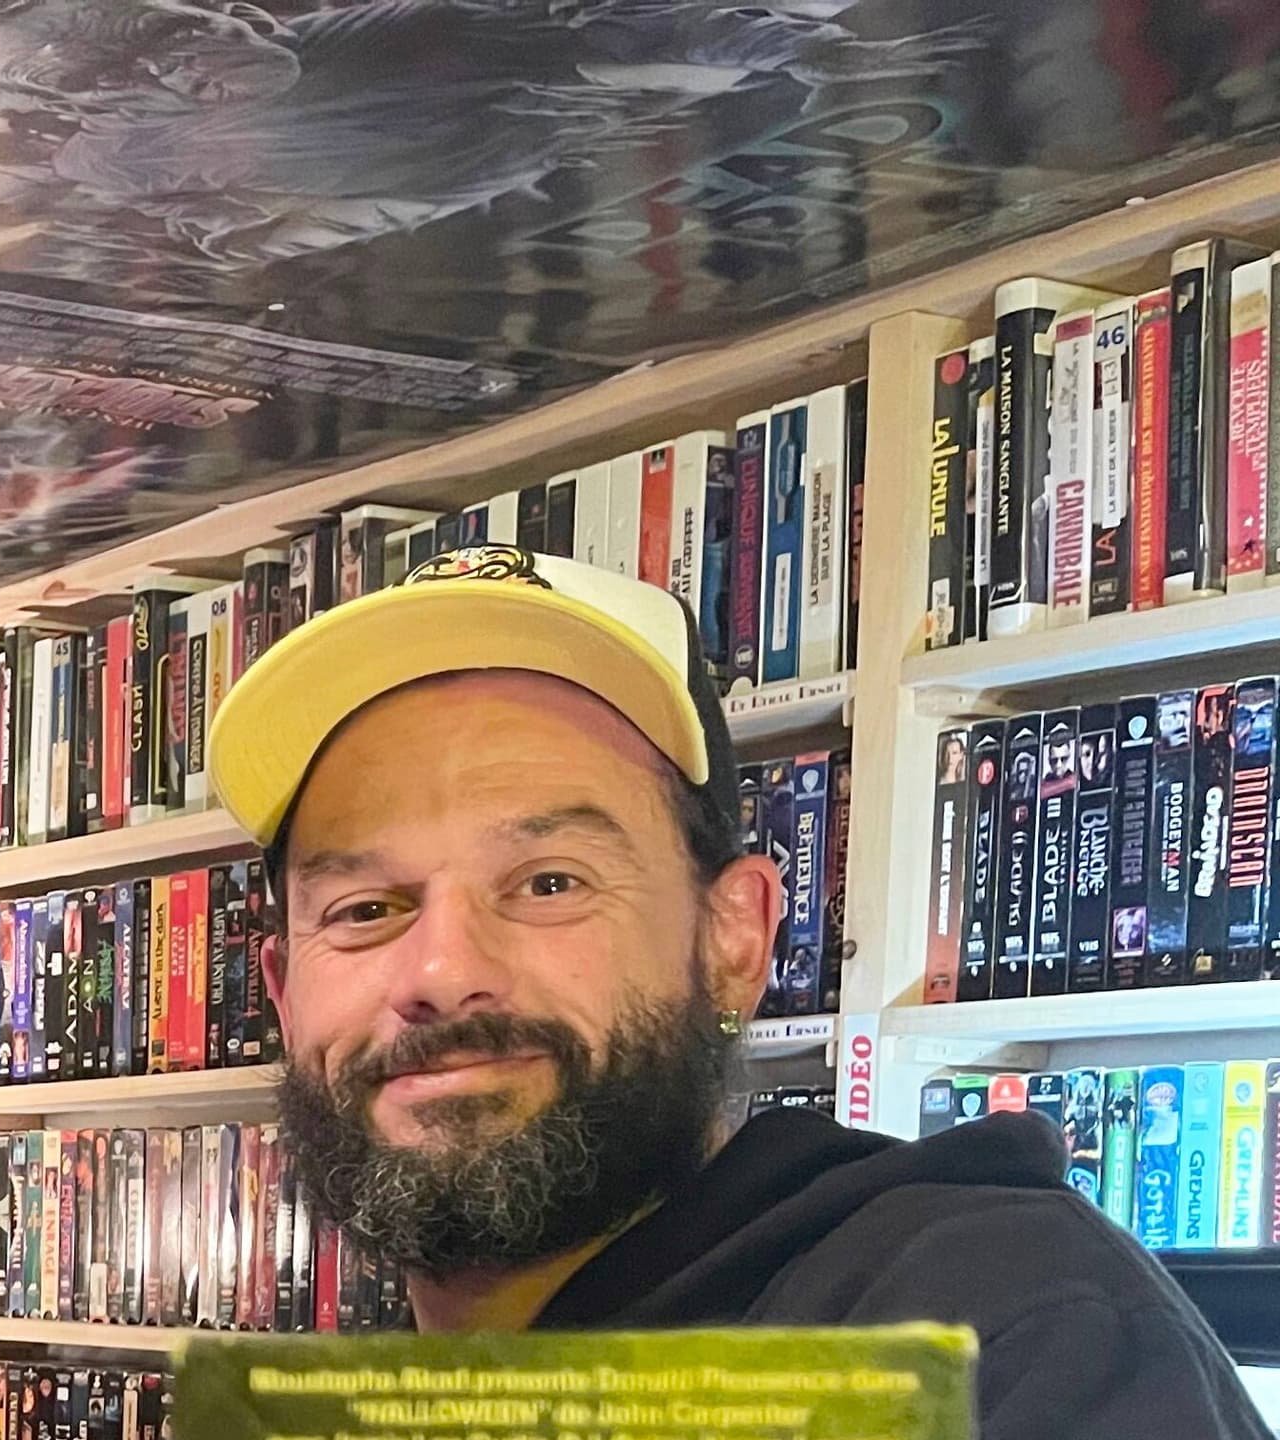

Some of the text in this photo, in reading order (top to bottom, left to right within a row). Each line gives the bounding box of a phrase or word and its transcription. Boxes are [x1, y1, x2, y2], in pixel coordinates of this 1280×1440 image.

[1096, 325, 1125, 349] 46
[996, 345, 1013, 536] LA MAISON SANGLANTE
[811, 472, 824, 522] MAISON
[821, 491, 832, 533] PLAGE
[820, 554, 830, 581] SUR
[1054, 480, 1084, 610] CANNIBALE
[809, 588, 820, 605] LA
[132, 684, 144, 752] CLASH
[1042, 797, 1061, 924] BLADE III
[1167, 781, 1183, 893] BOOGEYMAN
[64, 952, 77, 1042] ADAM
[1186, 1149, 1205, 1241] GREMLINS
[1231, 1126, 1253, 1240] GREMLINS
